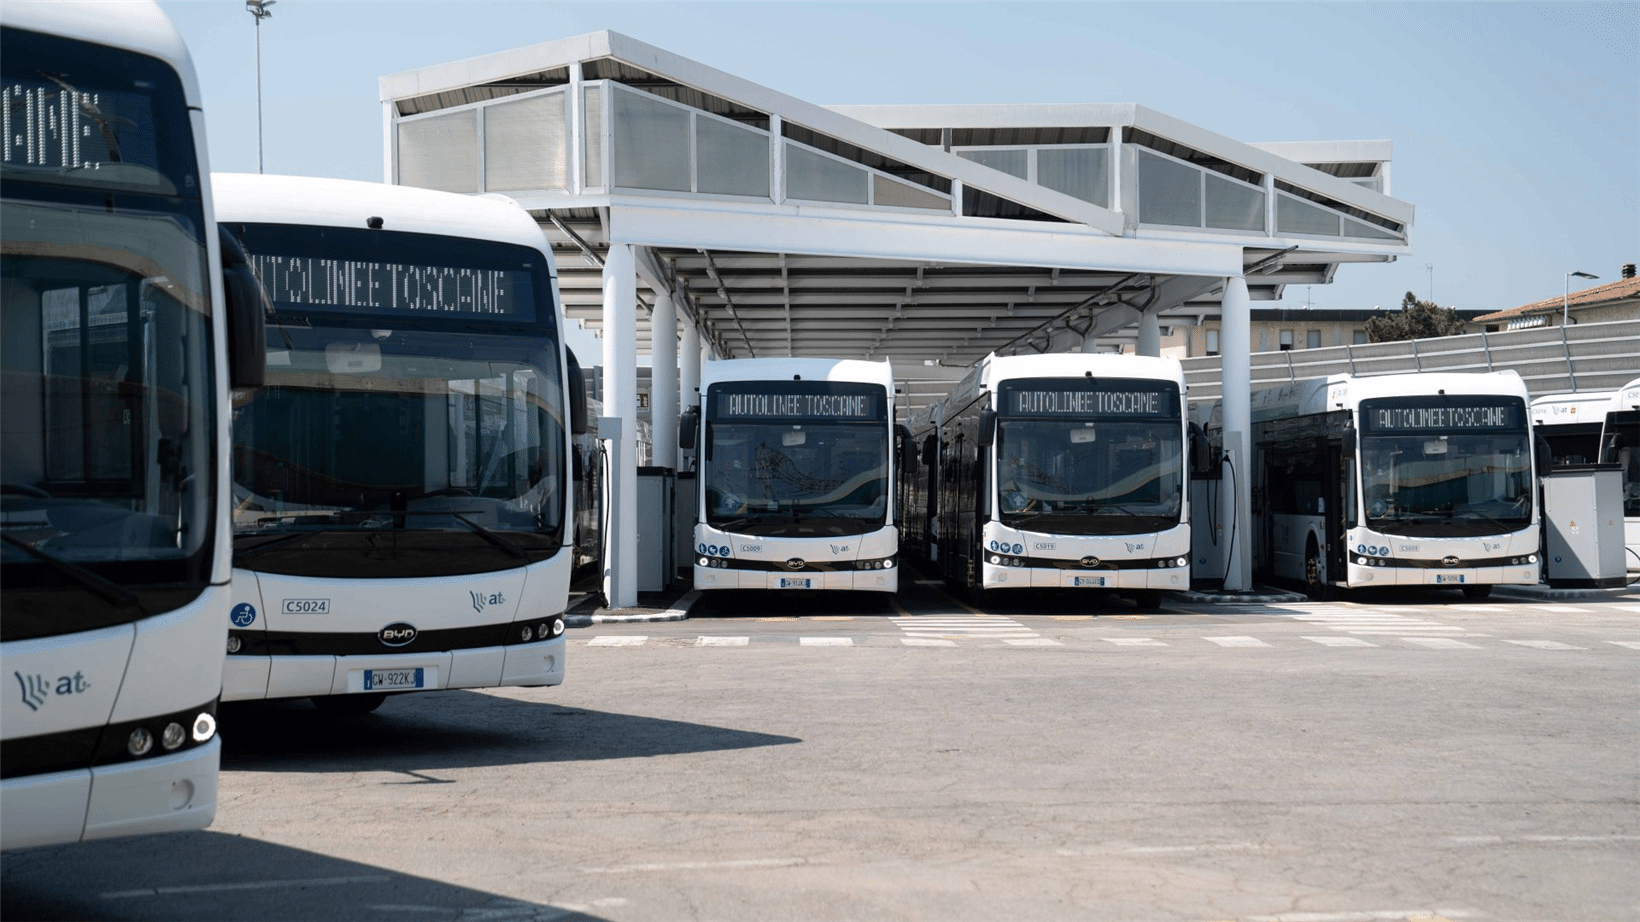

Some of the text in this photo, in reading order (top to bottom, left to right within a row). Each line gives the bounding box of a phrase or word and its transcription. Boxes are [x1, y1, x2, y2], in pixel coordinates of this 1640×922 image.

[252, 254, 504, 315] UTOLINEE TOSCANE
[729, 393, 867, 417] AUTOLINEE TOSCANE
[1019, 391, 1159, 413] AUTOLINEE TOSCANE
[1379, 406, 1505, 428] AUTOLINEE TOSCANE
[286, 601, 327, 613] C5024
[488, 591, 505, 605] at
[382, 627, 415, 640] BYD
[55, 670, 88, 696] at
